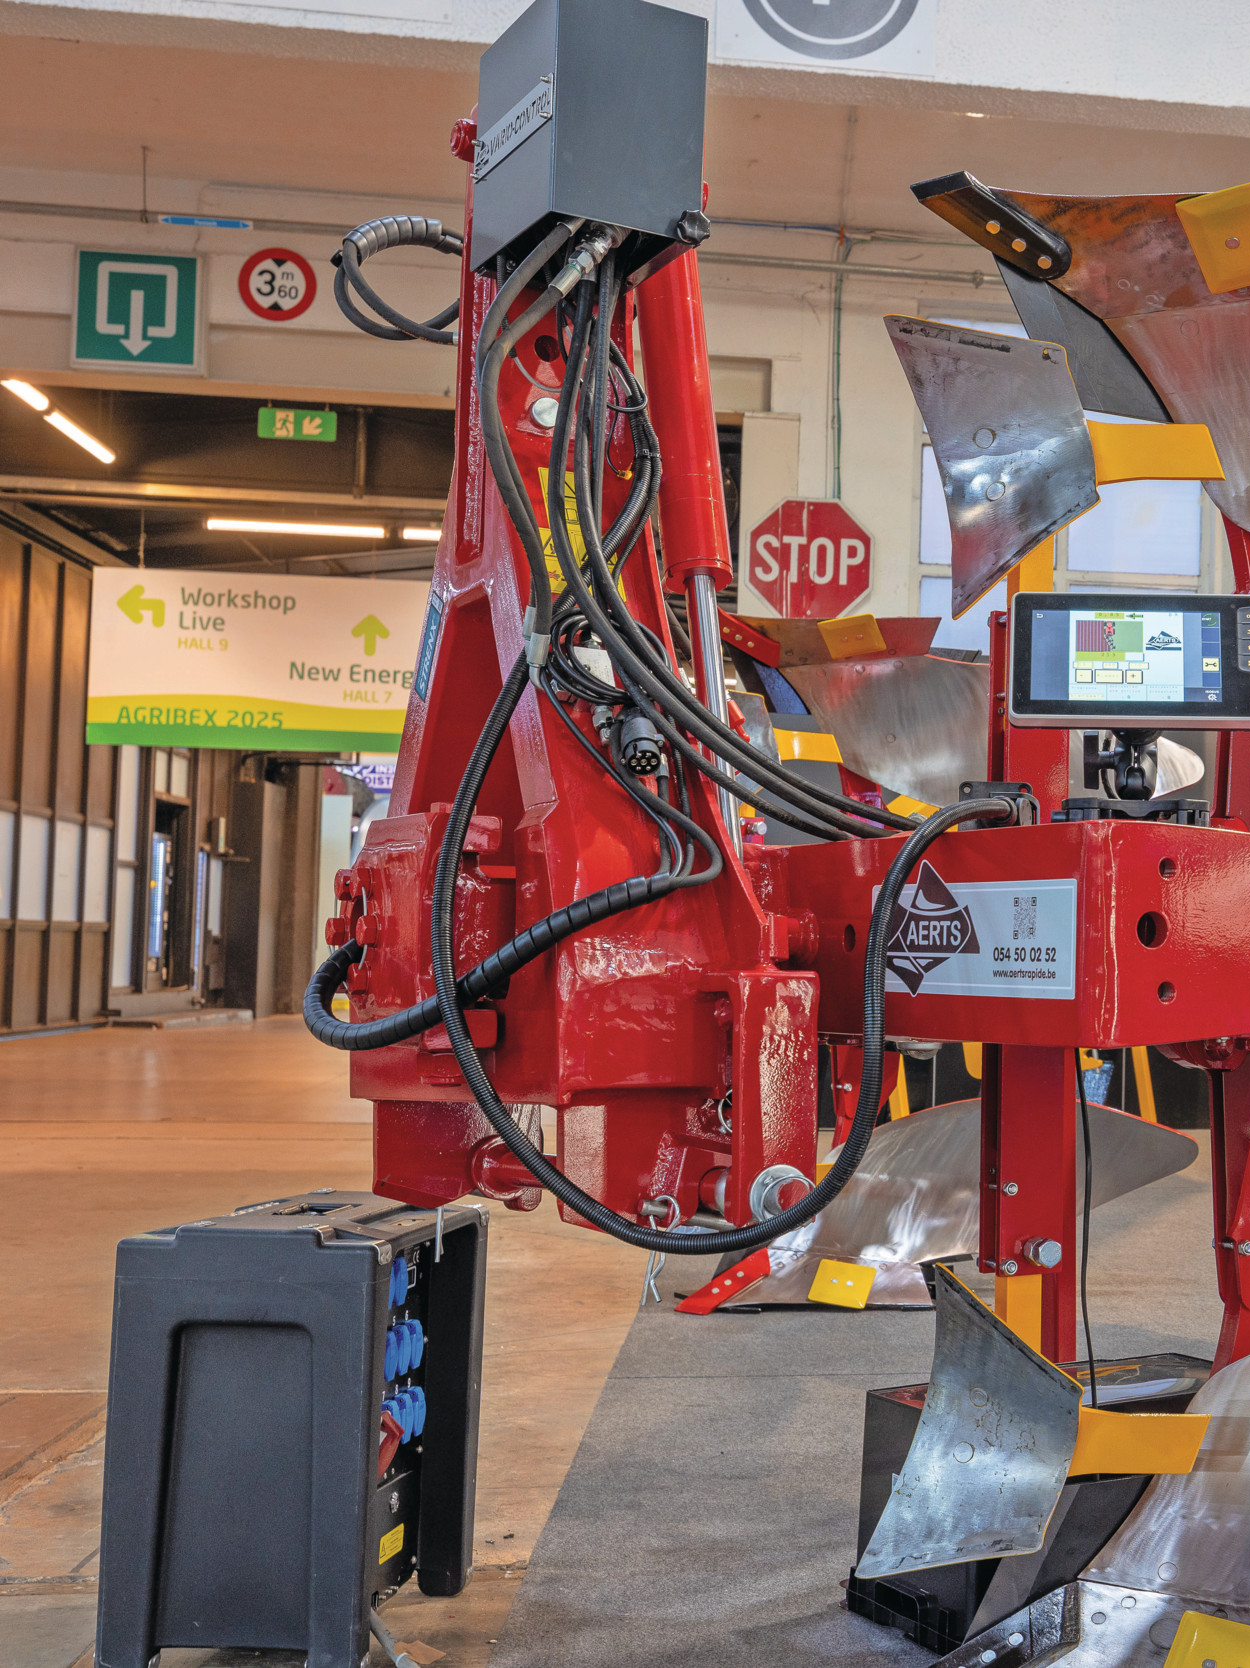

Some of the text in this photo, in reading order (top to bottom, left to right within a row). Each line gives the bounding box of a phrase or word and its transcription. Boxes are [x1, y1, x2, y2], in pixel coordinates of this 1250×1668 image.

[256, 270, 299, 299] 3 m 60
[755, 534, 865, 585] STOP
[181, 587, 297, 615] Workshop
[179, 611, 225, 631] Live
[177, 637, 228, 651] HALL 9
[289, 661, 341, 681] New
[343, 690, 392, 704] HALL 7
[118, 706, 284, 729] AGRIBEX 2025
[907, 920, 961, 946] AERTS
[993, 947, 1056, 962] 054 50 02 52
[993, 968, 1056, 981] www.aertsrapide.be
[392, 1315, 396, 1326] 5
[404, 1309, 409, 1321] 6
